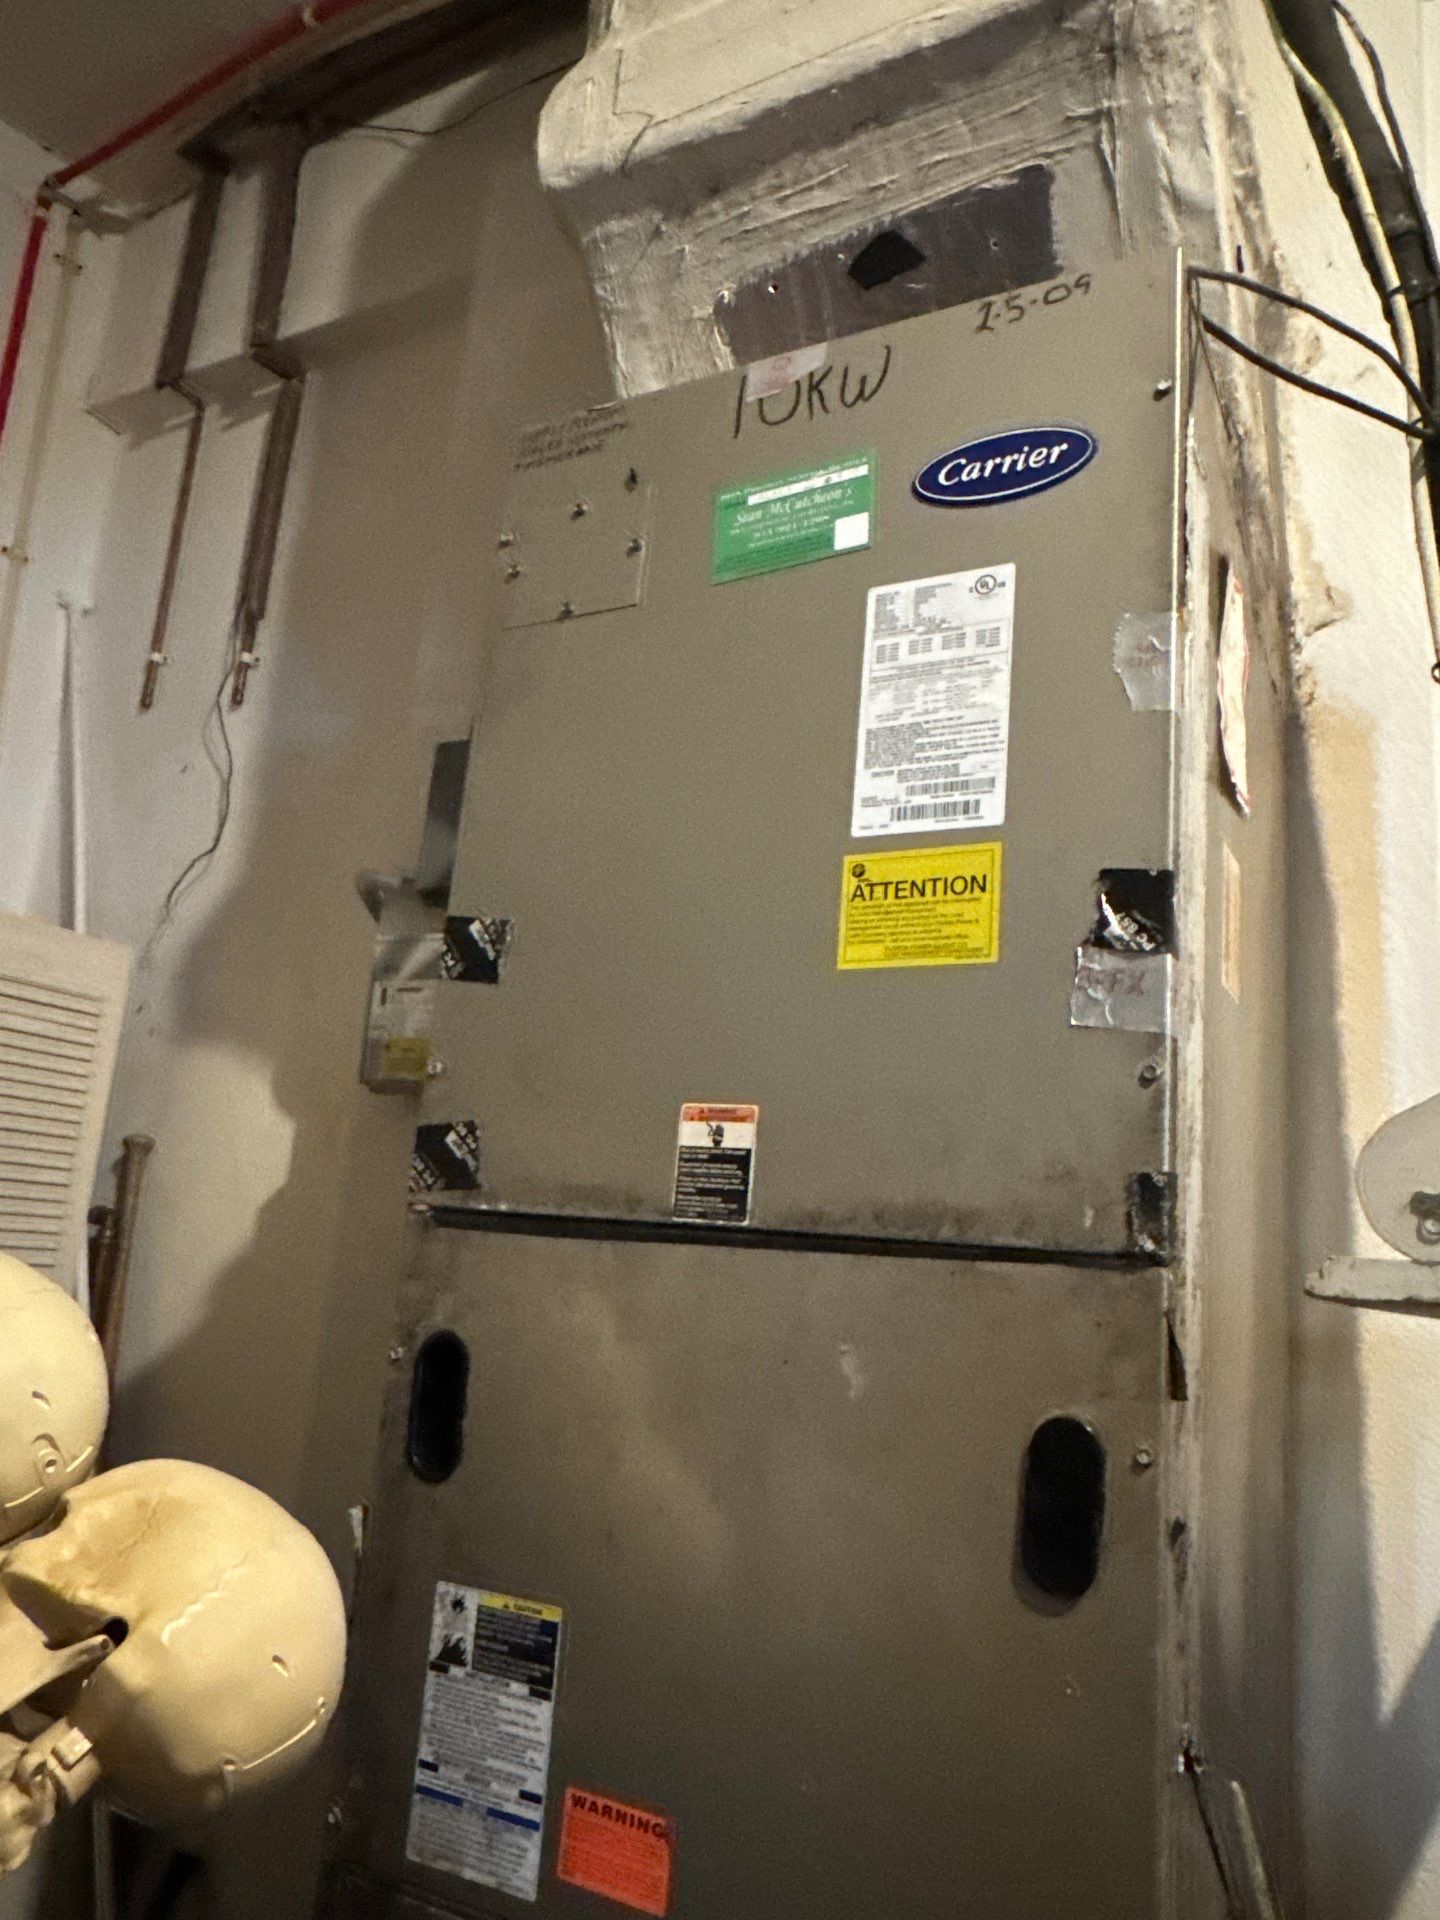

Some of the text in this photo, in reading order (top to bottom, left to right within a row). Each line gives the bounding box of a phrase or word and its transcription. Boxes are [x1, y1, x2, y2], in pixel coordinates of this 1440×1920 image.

[937, 442, 1069, 486] Carrier
[850, 873, 987, 903] ATTENTION
[570, 1792, 670, 1841] WARNING
